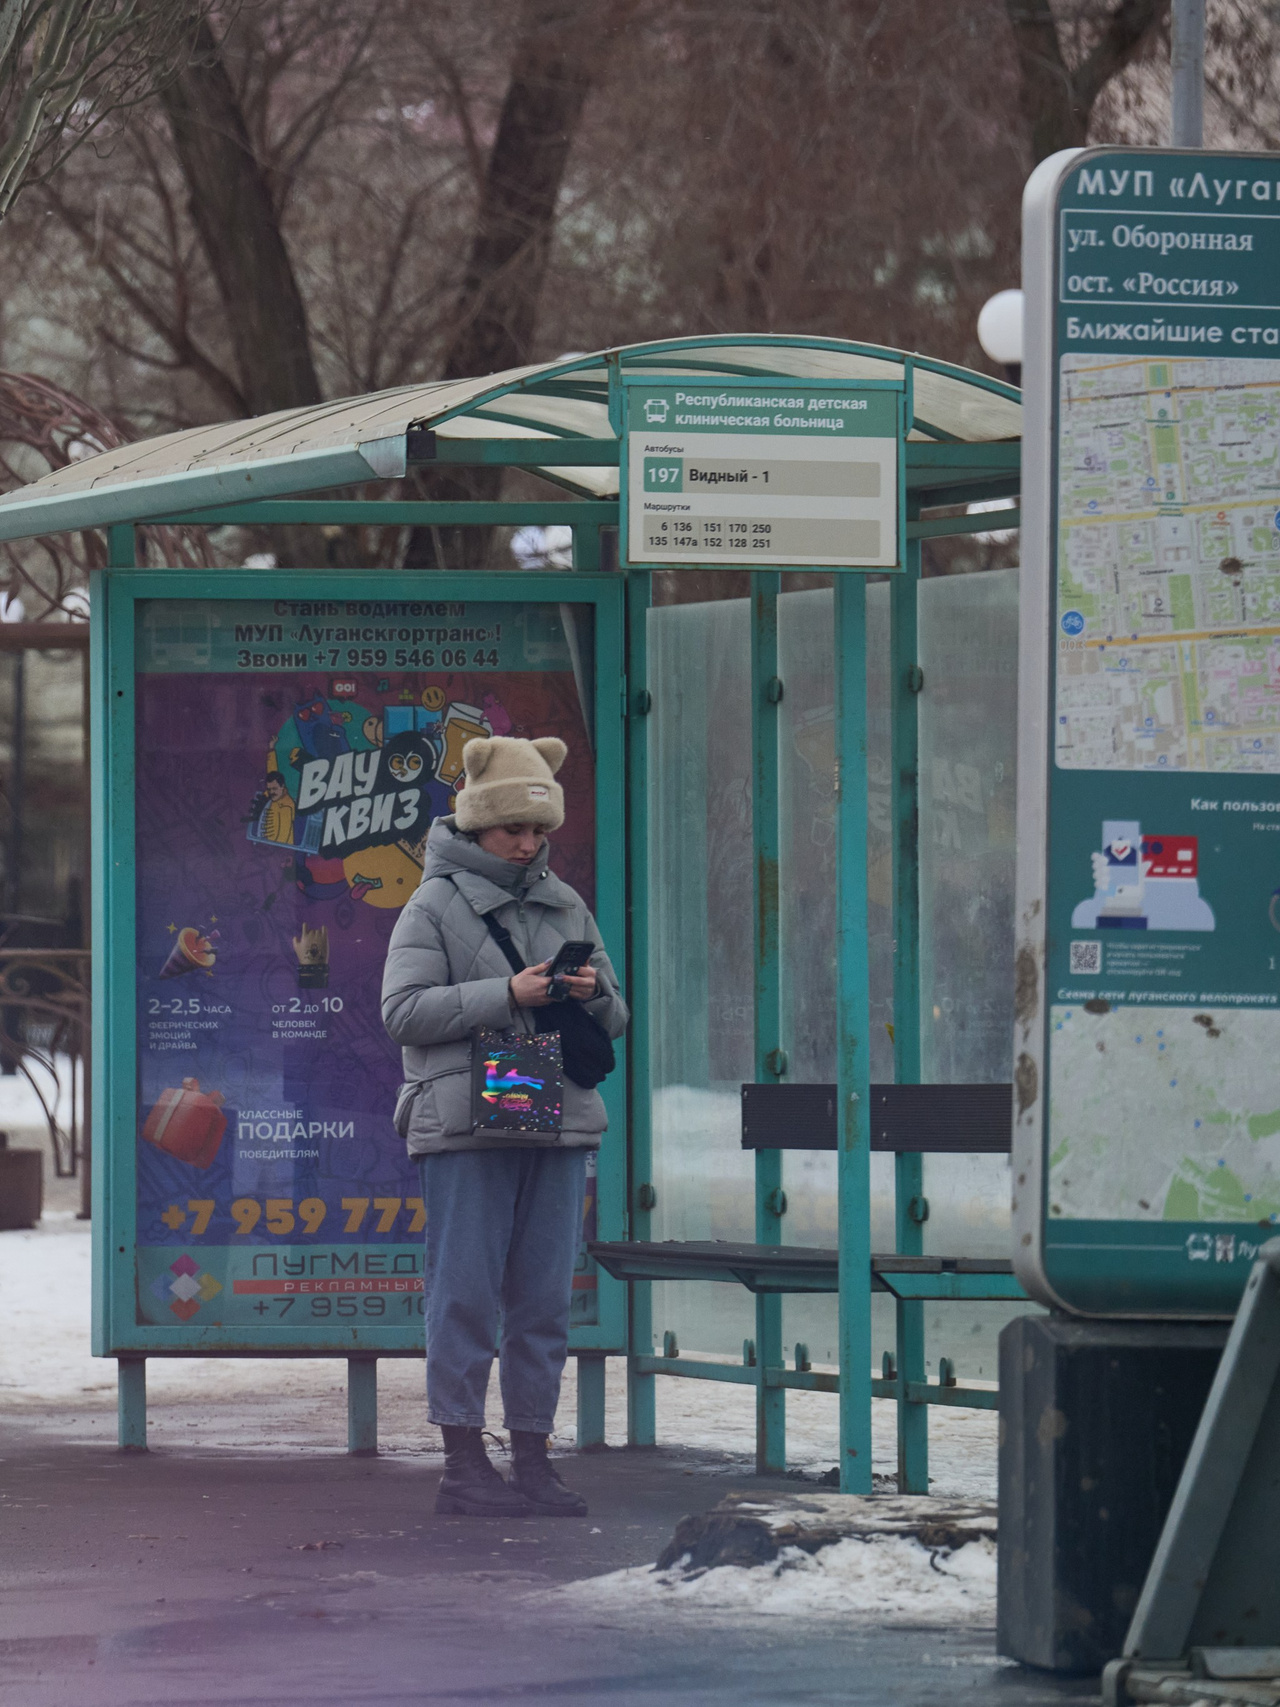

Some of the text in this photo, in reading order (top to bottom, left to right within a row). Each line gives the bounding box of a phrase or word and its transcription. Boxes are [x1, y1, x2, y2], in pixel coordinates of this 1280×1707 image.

[1077, 169, 1280, 205] МУП «Луга
[1068, 224, 1254, 255] ул. Оборонная
[1067, 272, 1239, 296] ост. «Россия»
[1066, 317, 1223, 343] Ближайшие
[675, 392, 867, 413] Республиканская детская
[675, 413, 844, 431] клиническая больница
[644, 445, 684, 454] Автобусы
[648, 467, 679, 483] 197
[689, 468, 748, 484] Видный
[762, 470, 769, 483] 1
[644, 502, 691, 512] Маршрутки
[661, 522, 771, 534] 6 136 151 170 250
[649, 536, 771, 549] 135 147а 152 128 251
[273, 600, 466, 619] Стань водителем
[234, 624, 502, 646] МУП «Луганскгортранс»!
[237, 649, 500, 668] Звони +7 959 546 06 44
[335, 683, 356, 693] GO!
[298, 750, 382, 810] ВАУ
[1190, 797, 1219, 811] Как
[322, 788, 421, 847] КВИЗ
[203, 1005, 232, 1014] ЧАСА
[288, 997, 301, 1013] 2
[321, 996, 344, 1013] 10
[148, 1021, 219, 1029] ФЕЕРИЧЕСКИХ
[272, 1020, 316, 1028] ЧЕЛОВЕК
[149, 1030, 192, 1041] ЭМОЦИЙ
[272, 1030, 328, 1039] В КОМАНДЕ
[149, 1041, 198, 1051] И ДРАЙВА
[238, 1109, 303, 1119] КЛАССНЫЕ
[238, 1121, 355, 1141] ПОДАРКИ
[239, 1149, 320, 1160] ПОБЕДИТЕЛЯМ
[161, 1198, 427, 1235] +7 959 777
[253, 1297, 296, 1318] +7
[310, 1296, 386, 1318] 959
